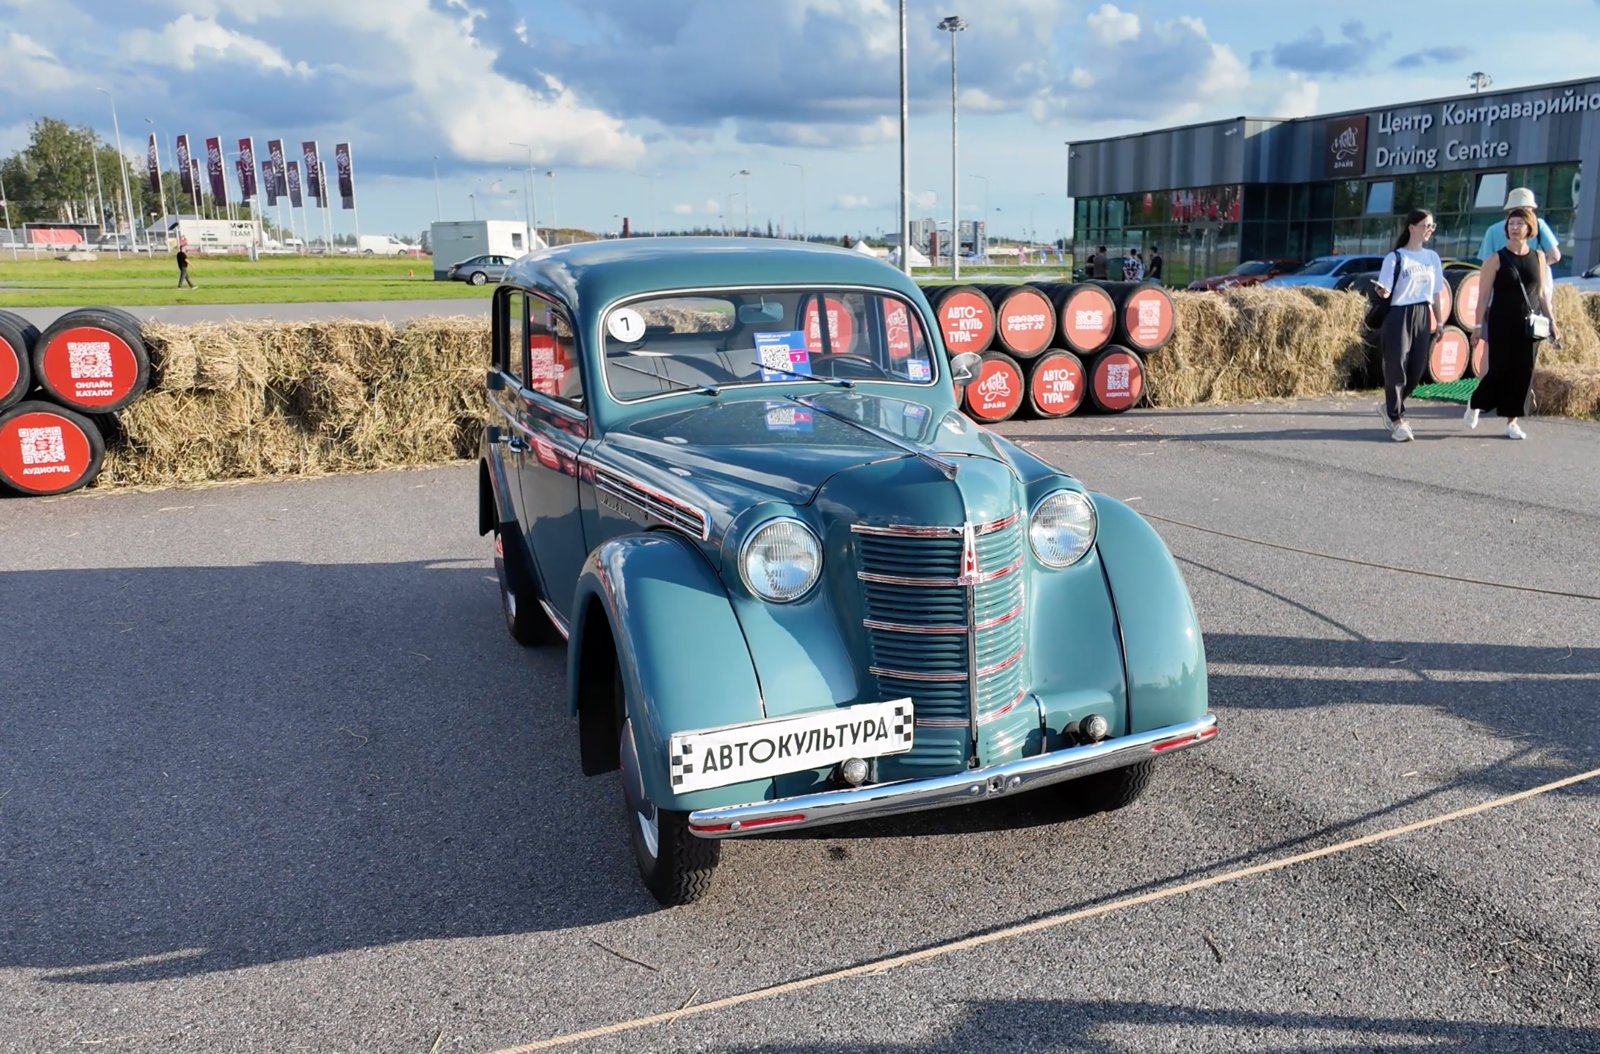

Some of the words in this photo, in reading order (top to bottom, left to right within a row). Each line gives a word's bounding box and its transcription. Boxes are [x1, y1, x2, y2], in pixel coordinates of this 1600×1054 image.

[1378, 112, 1433, 136] Центр
[1442, 89, 1600, 127] Контраварийно
[1376, 145, 1438, 169] Driving
[1446, 140, 1509, 161] Centre
[620, 317, 630, 331] 7
[1075, 310, 1103, 325] ROS
[75, 381, 113, 389] ОНЛАЙН
[75, 389, 114, 397] КАТАЛОГ
[982, 401, 1006, 410] ДРАЙВ
[22, 465, 71, 475] АУДИОГИД
[701, 716, 889, 774] АВТОКУЛЬТУРА
